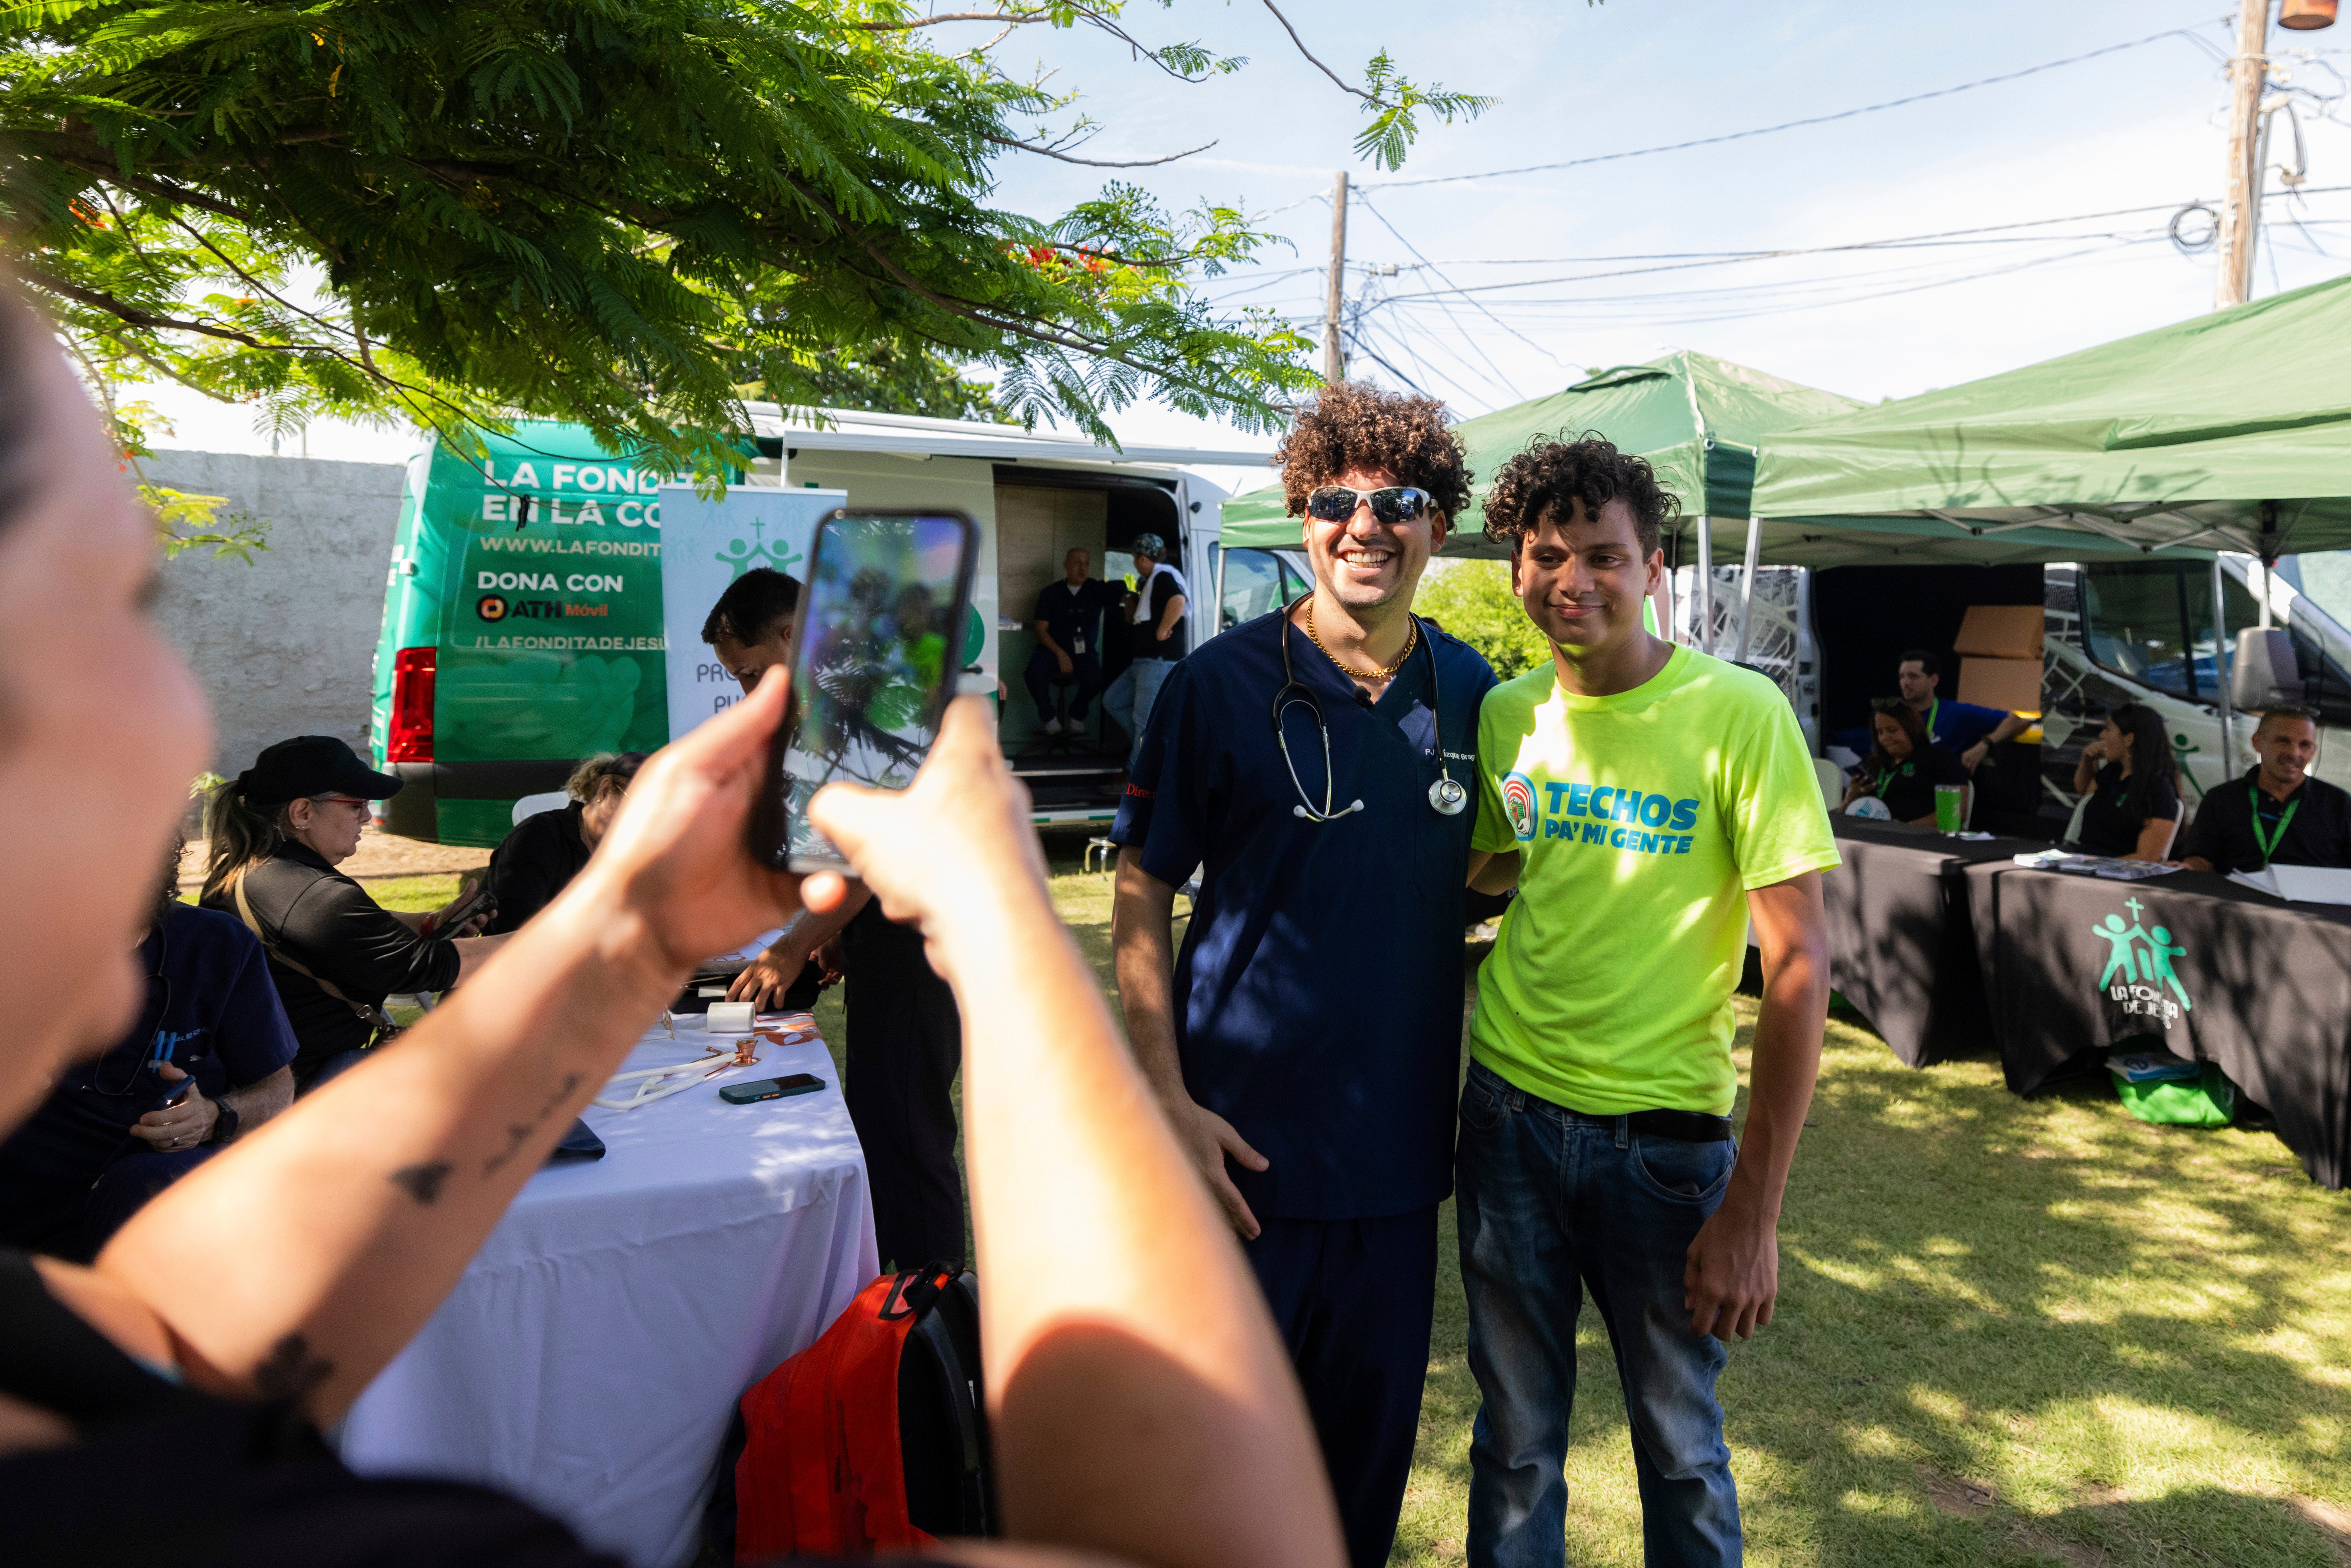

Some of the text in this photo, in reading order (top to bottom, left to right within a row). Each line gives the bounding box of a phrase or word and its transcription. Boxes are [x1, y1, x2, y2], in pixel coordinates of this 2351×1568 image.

[484, 460, 540, 488] LA
[483, 494, 539, 522] EN
[551, 498, 606, 526] LA
[477, 571, 623, 592] DONA CON
[511, 600, 608, 618] ATH Móvil
[1545, 782, 1700, 831] TECHOS
[1582, 822, 1608, 845] MI
[1611, 828, 1694, 854] GENTE
[2110, 985, 2128, 1001] LA
